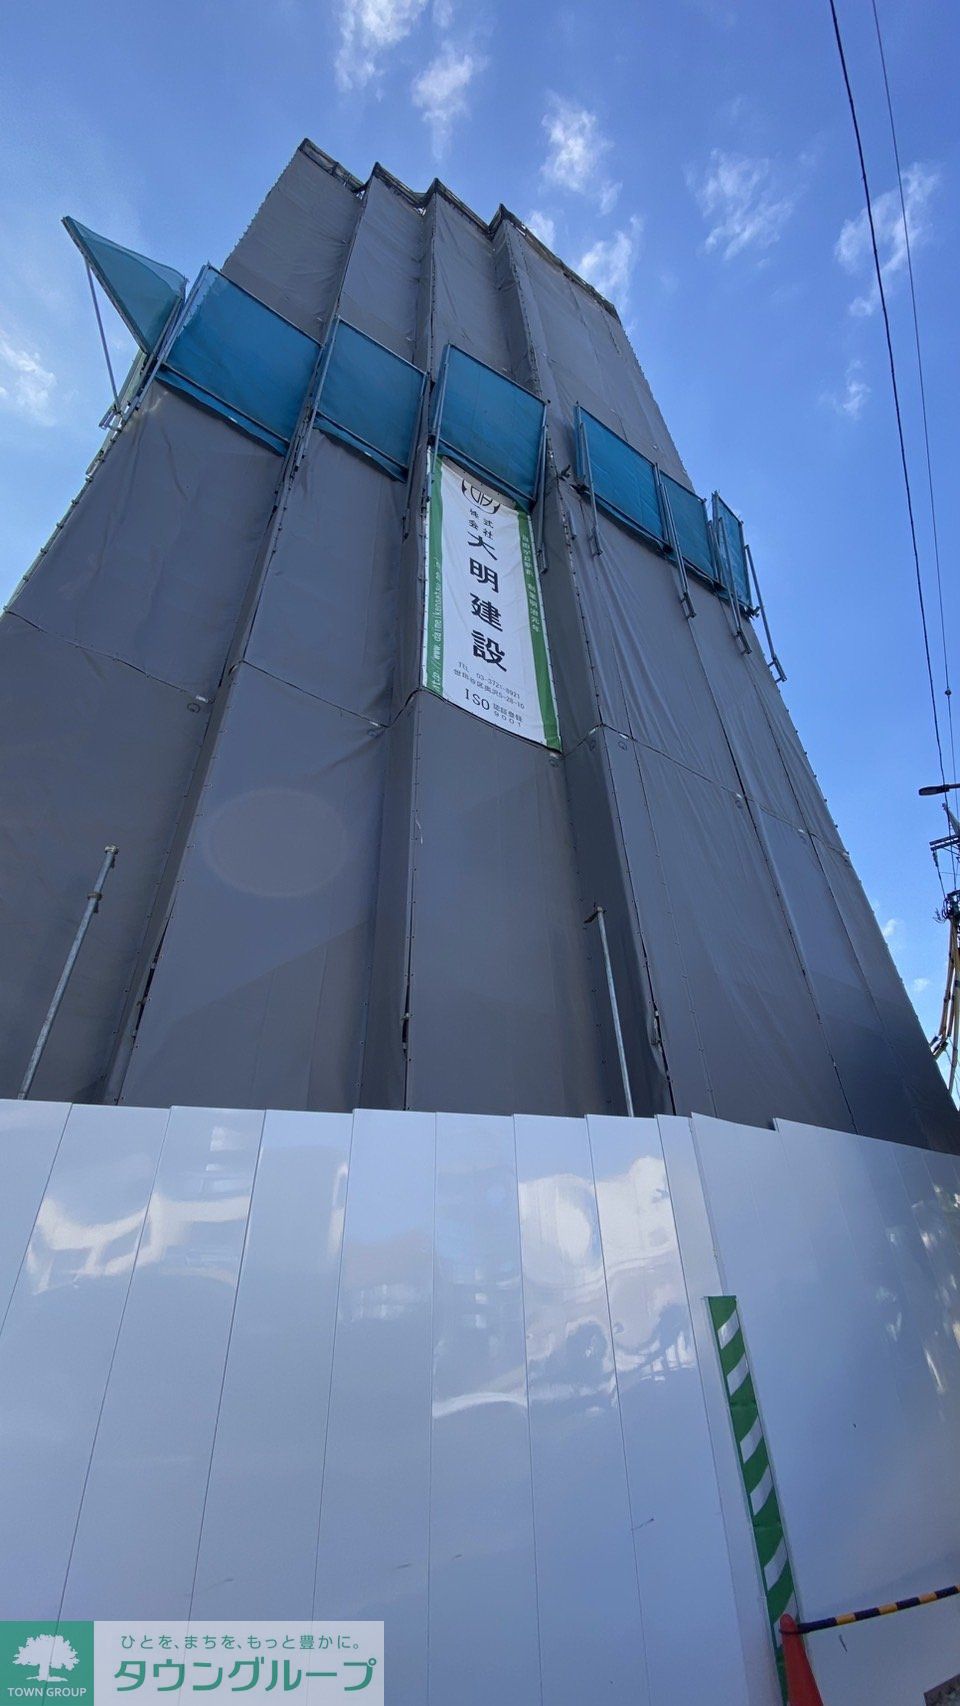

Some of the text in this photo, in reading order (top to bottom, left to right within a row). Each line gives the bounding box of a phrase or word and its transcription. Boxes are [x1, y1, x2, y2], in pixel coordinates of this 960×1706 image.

[467, 531, 507, 672] 大明建設
[458, 661, 469, 673] TEL
[464, 688, 490, 711] ISO
